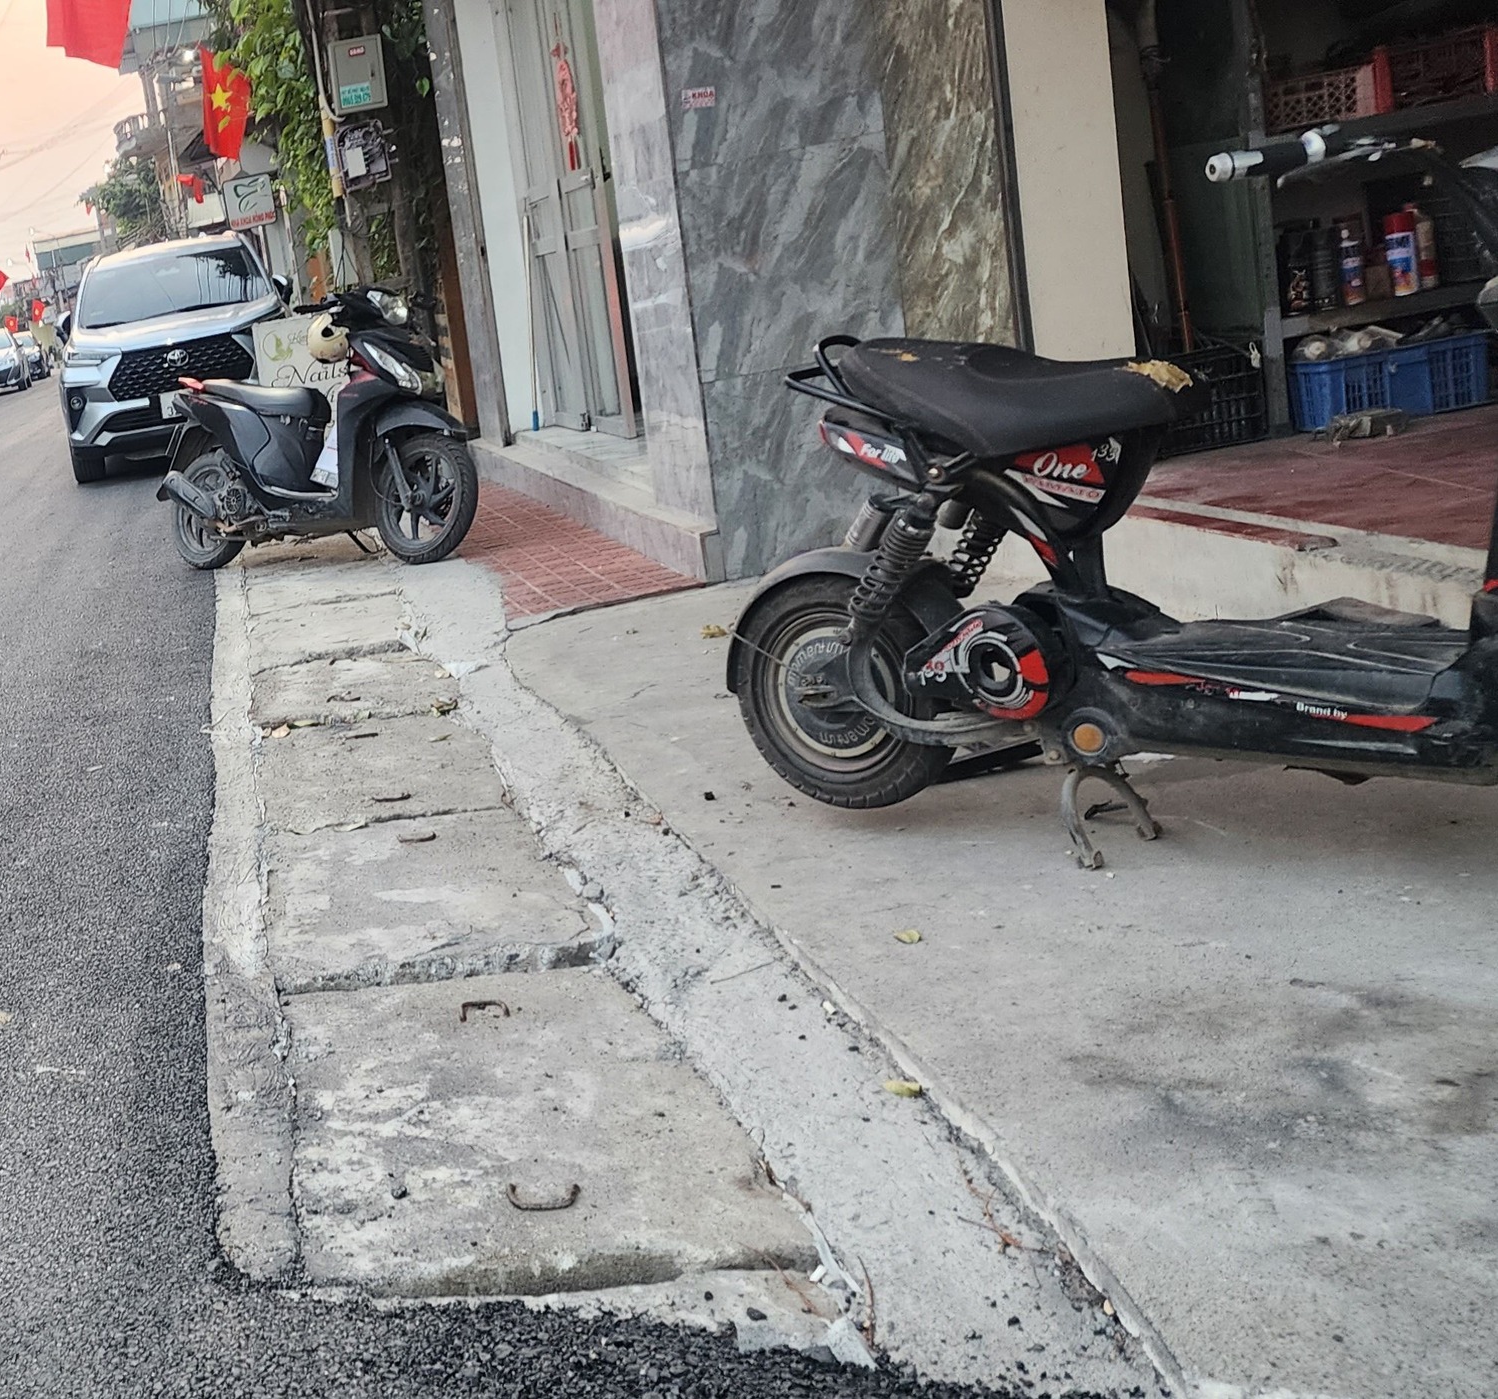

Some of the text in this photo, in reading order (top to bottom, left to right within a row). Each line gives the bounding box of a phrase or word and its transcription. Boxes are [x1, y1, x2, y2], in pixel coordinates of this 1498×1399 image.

[271, 360, 348, 388] Nails
[1033, 452, 1092, 479] One
[1296, 700, 1332, 718] Brand
